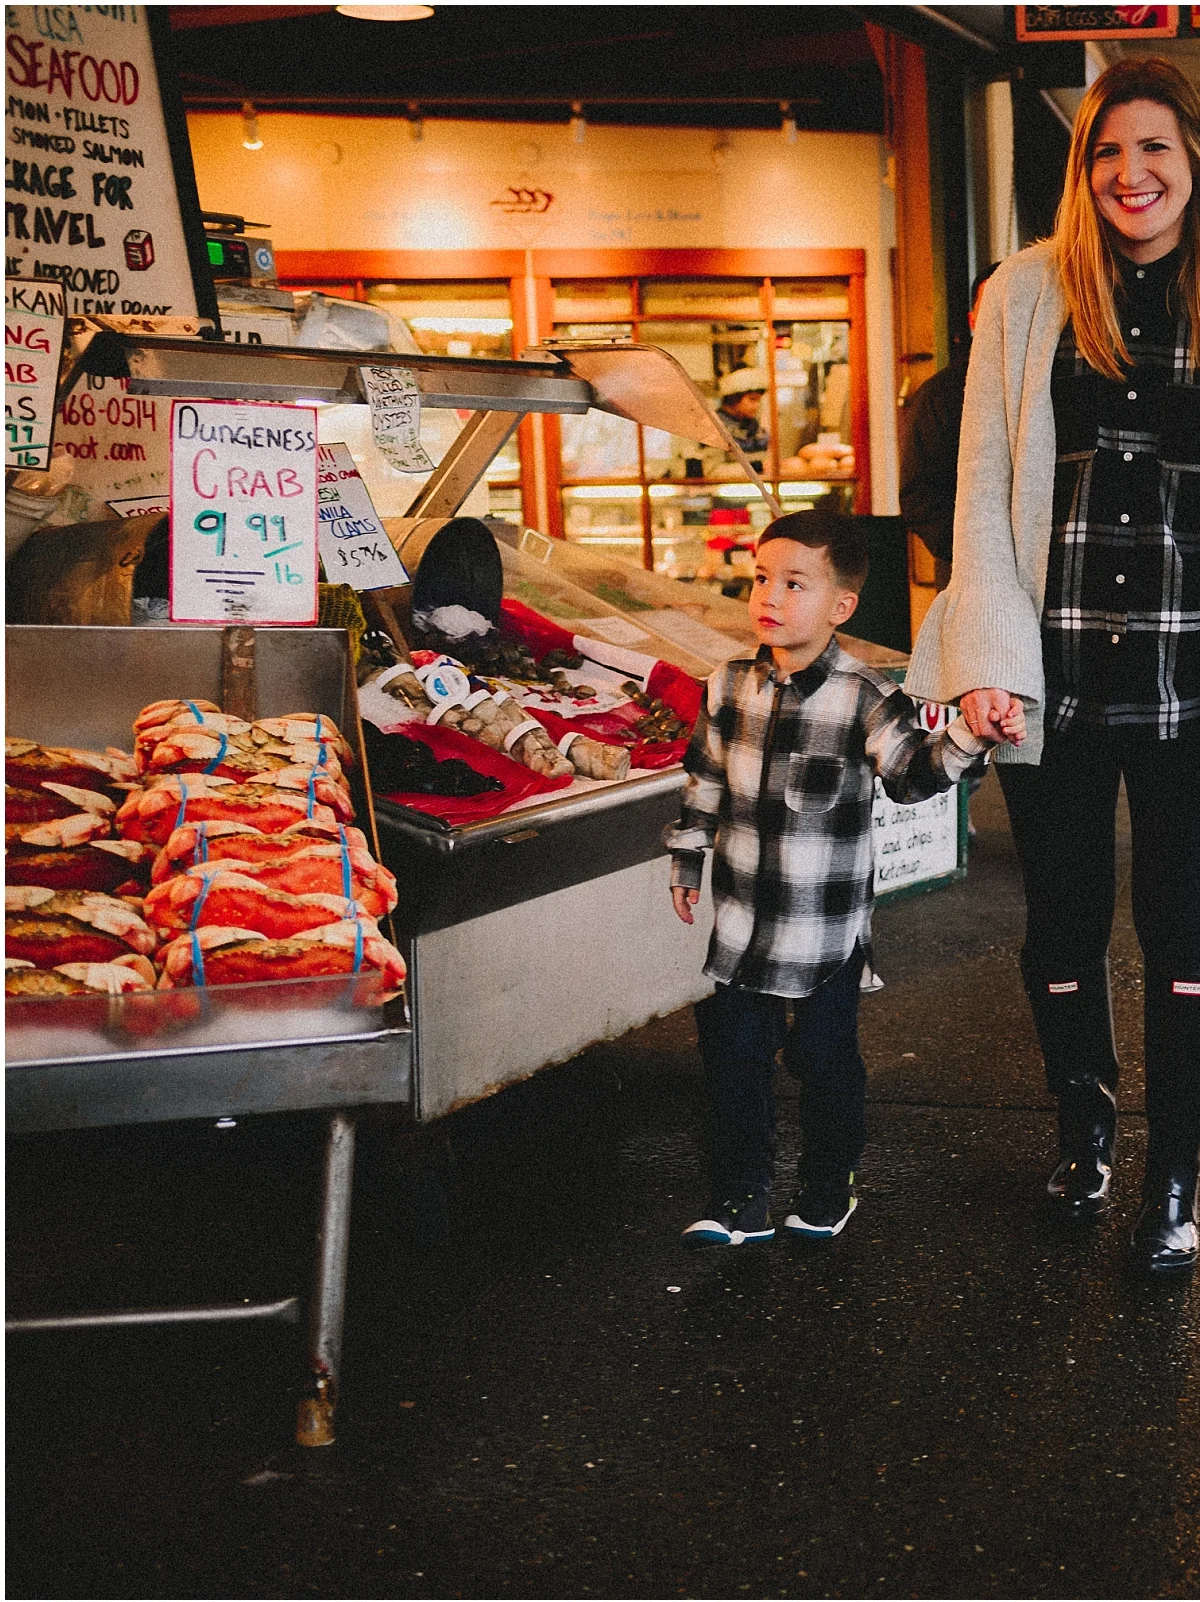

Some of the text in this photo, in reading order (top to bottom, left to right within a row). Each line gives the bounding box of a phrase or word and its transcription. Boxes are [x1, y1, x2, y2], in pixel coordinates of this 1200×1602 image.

[6, 34, 139, 106] SEAFOOD
[5, 95, 130, 139] MON FILLETS
[12, 127, 145, 168] SMOKED SALMON
[92, 172, 133, 210] FOR
[5, 287, 64, 316] KAN
[192, 448, 304, 499] CRAB
[331, 518, 376, 539] CLAMS
